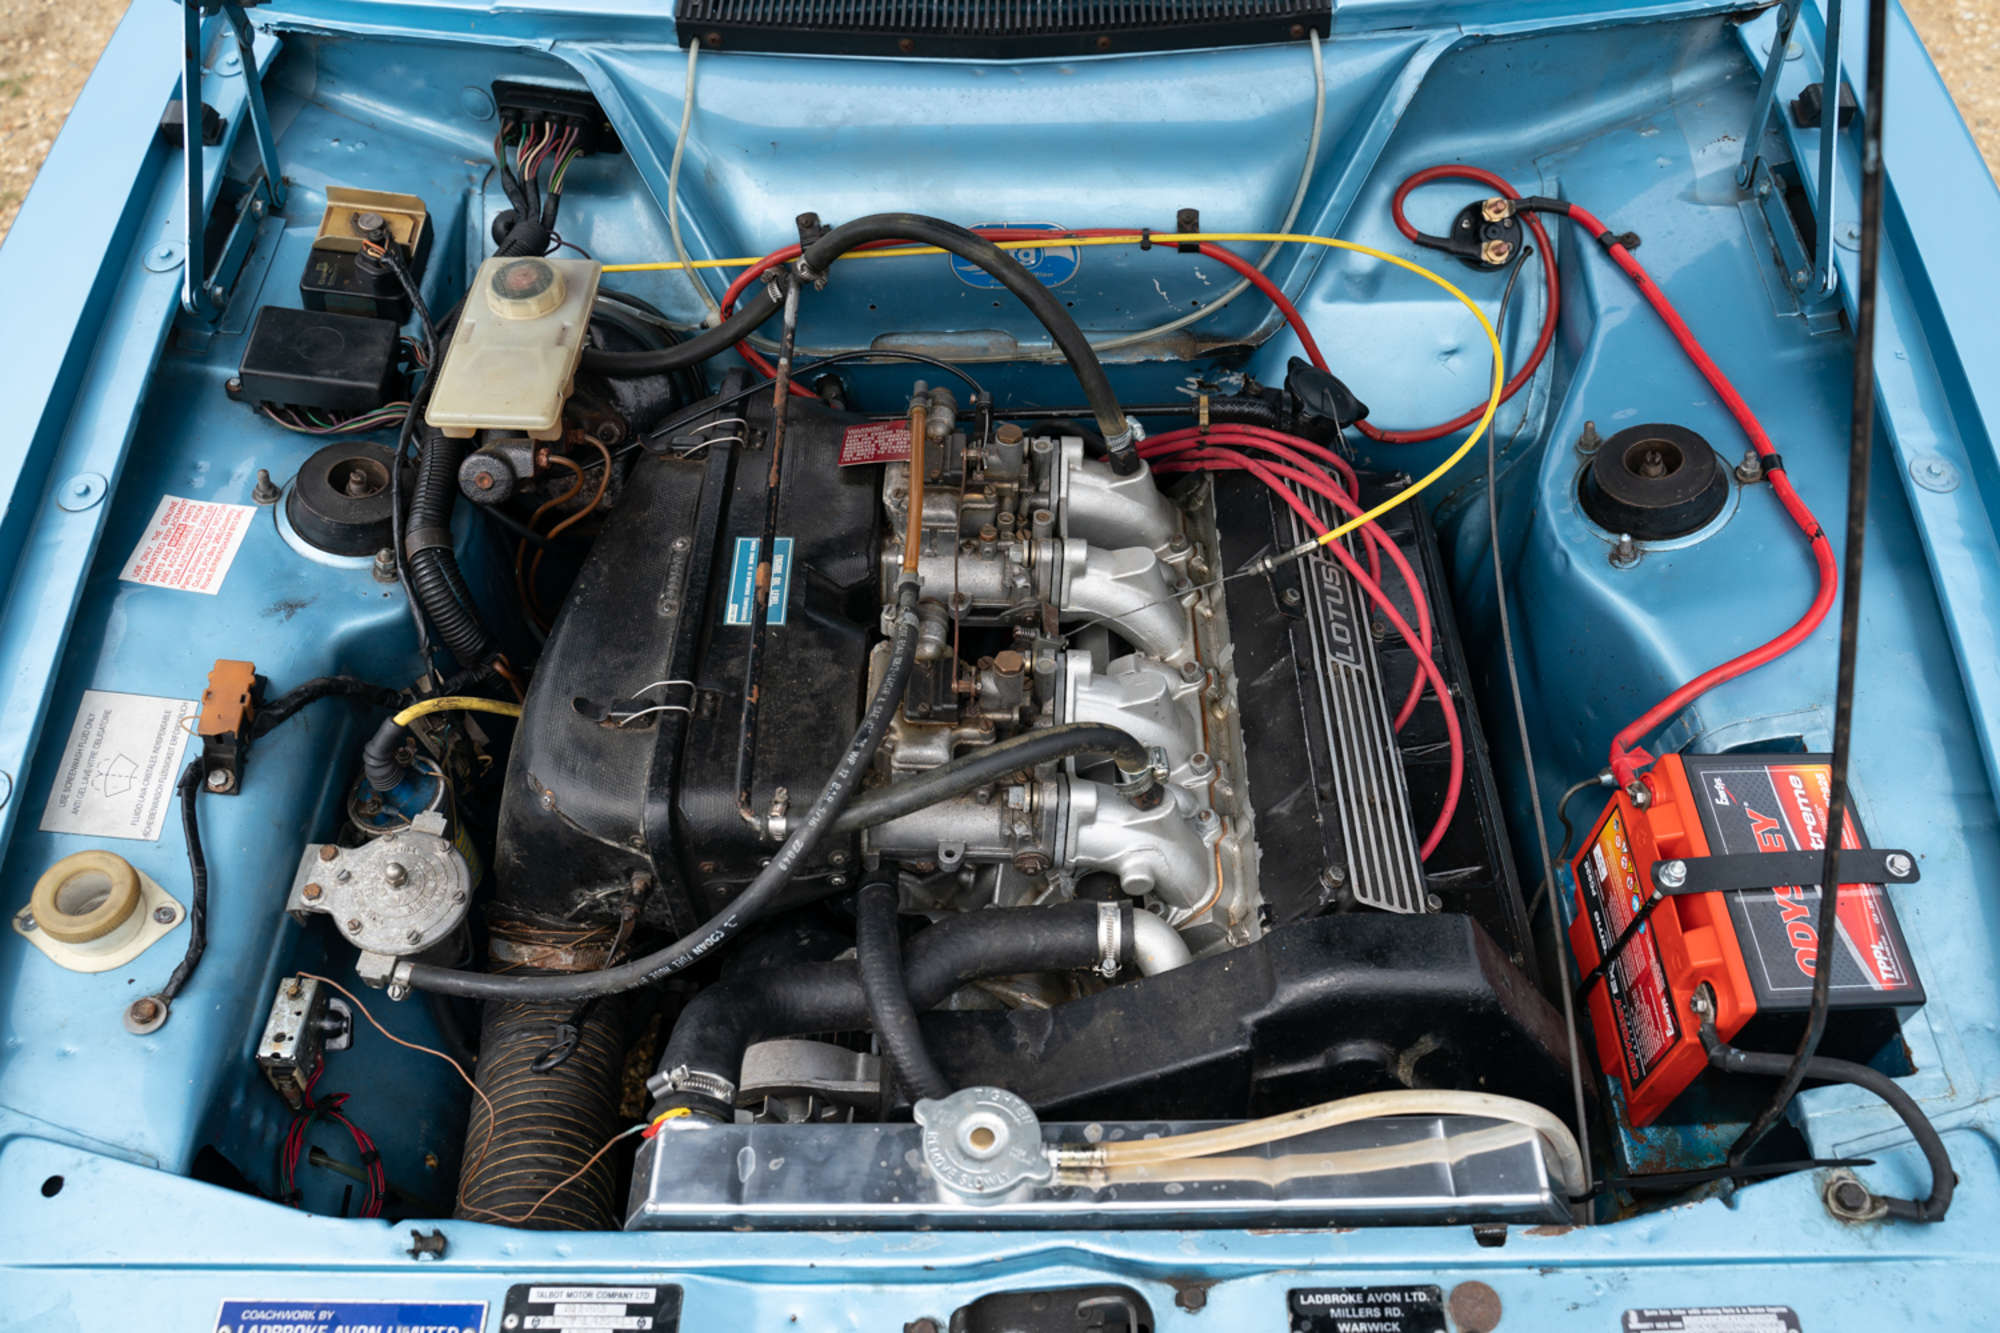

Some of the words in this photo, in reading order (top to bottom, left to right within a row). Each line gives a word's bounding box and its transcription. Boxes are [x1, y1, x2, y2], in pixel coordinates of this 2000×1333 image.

[159, 500, 178, 526] GENUINE
[138, 542, 166, 582] GUARANTEED
[161, 499, 188, 540] REPLACEMENT
[149, 562, 164, 582] PARTS
[1321, 564, 1355, 662] LOTUS
[83, 712, 95, 728] ONLY
[92, 710, 111, 748] OBLIGATOIRE
[77, 730, 90, 747] FLUID
[63, 748, 82, 792] SCREENWASH
[130, 803, 142, 825] FLUIDO
[142, 756, 157, 786] CRISTALES
[152, 710, 170, 752] INDISPENSABLE
[1788, 774, 1824, 848] treme
[1748, 810, 1816, 974] ODYSEY
[1870, 940, 1894, 980] TPPL
[1614, 996, 1638, 1080] ODYSSEY
[975, 1089, 1034, 1124] TIGHTEN
[928, 1131, 957, 1180] REMOVE
[960, 1170, 1010, 1187] SLOWLY
[596, 1291, 632, 1299] COMPANY
[1300, 1294, 1363, 1304] LADBROKE
[1366, 1293, 1401, 1303] AVON
[1405, 1292, 1430, 1302] LTD.
[1330, 1307, 1381, 1318] MILLERS
[1384, 1307, 1404, 1317] RD.
[241, 1309, 315, 1321] COACHWORK
[319, 1310, 335, 1321] BY
[1337, 1322, 1400, 1333] WARWICK
